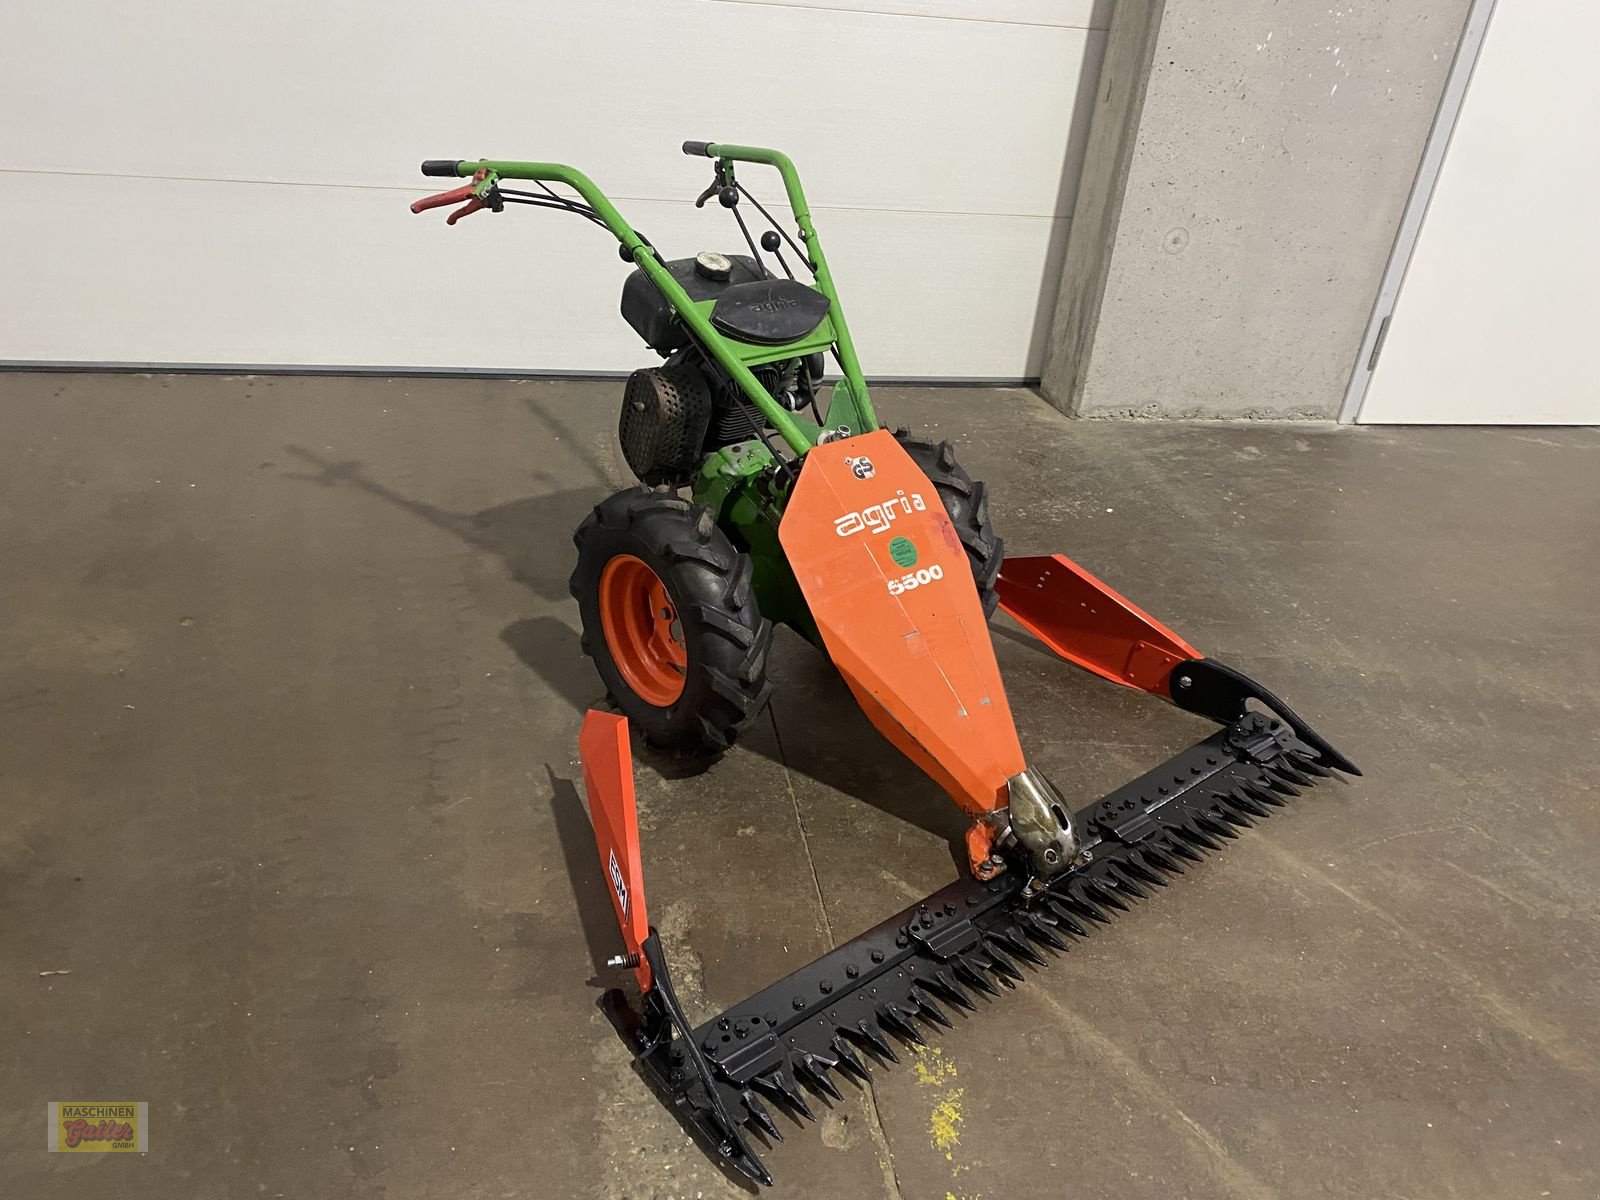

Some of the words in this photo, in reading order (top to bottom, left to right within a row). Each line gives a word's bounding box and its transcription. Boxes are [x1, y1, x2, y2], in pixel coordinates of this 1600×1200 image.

[748, 297, 801, 314] agria
[833, 489, 926, 537] agria
[887, 564, 944, 596] 5500
[610, 854, 627, 908] ESM
